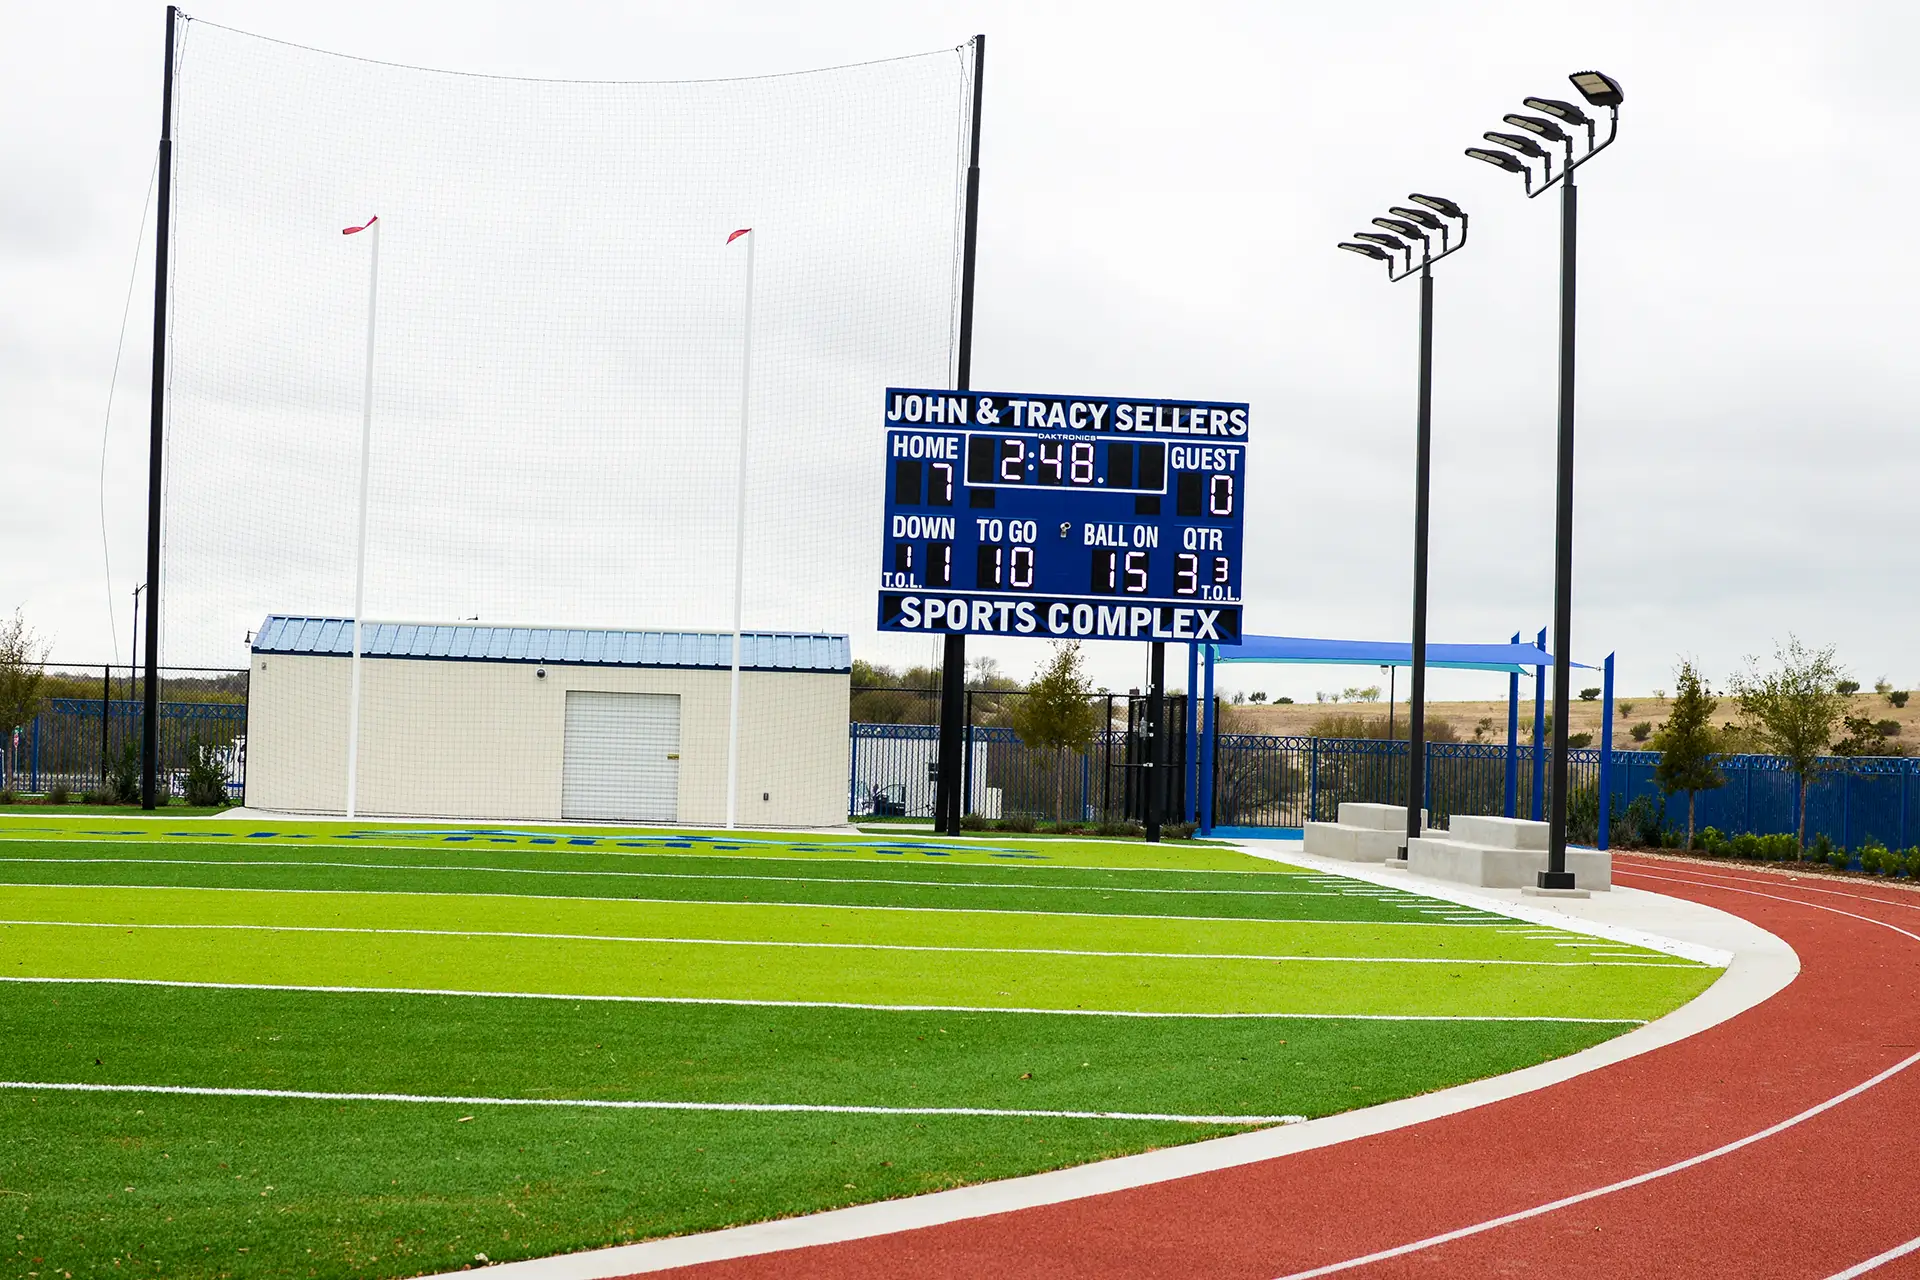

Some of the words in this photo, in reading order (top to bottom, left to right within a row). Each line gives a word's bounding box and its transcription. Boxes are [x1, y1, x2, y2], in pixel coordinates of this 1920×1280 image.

[887, 394, 968, 424] JOHN
[976, 397, 1000, 424] &
[1008, 400, 1109, 430] TRACY
[1115, 404, 1247, 436] SELLERS
[893, 435, 959, 459] HOME
[1038, 433, 1096, 441] DAKTRONICS
[1171, 446, 1239, 471] GUEST
[932, 462, 953, 502] 7
[1210, 474, 1234, 515] 0
[892, 515, 955, 540] DOWN
[976, 519, 1003, 542] TO
[1008, 520, 1037, 543] GO
[1084, 523, 1128, 547] BALL
[1133, 524, 1159, 548] ON
[1183, 527, 1223, 551] QTR
[995, 546, 1034, 587] 10
[1109, 551, 1147, 592] 15
[1177, 553, 1198, 594] 3
[1215, 557, 1229, 582] 3
[883, 572, 923, 589] T.O.L.
[1201, 585, 1240, 601] T.O.L.
[899, 596, 1036, 633] SPORTS
[1048, 603, 1220, 640] COMPLEX
